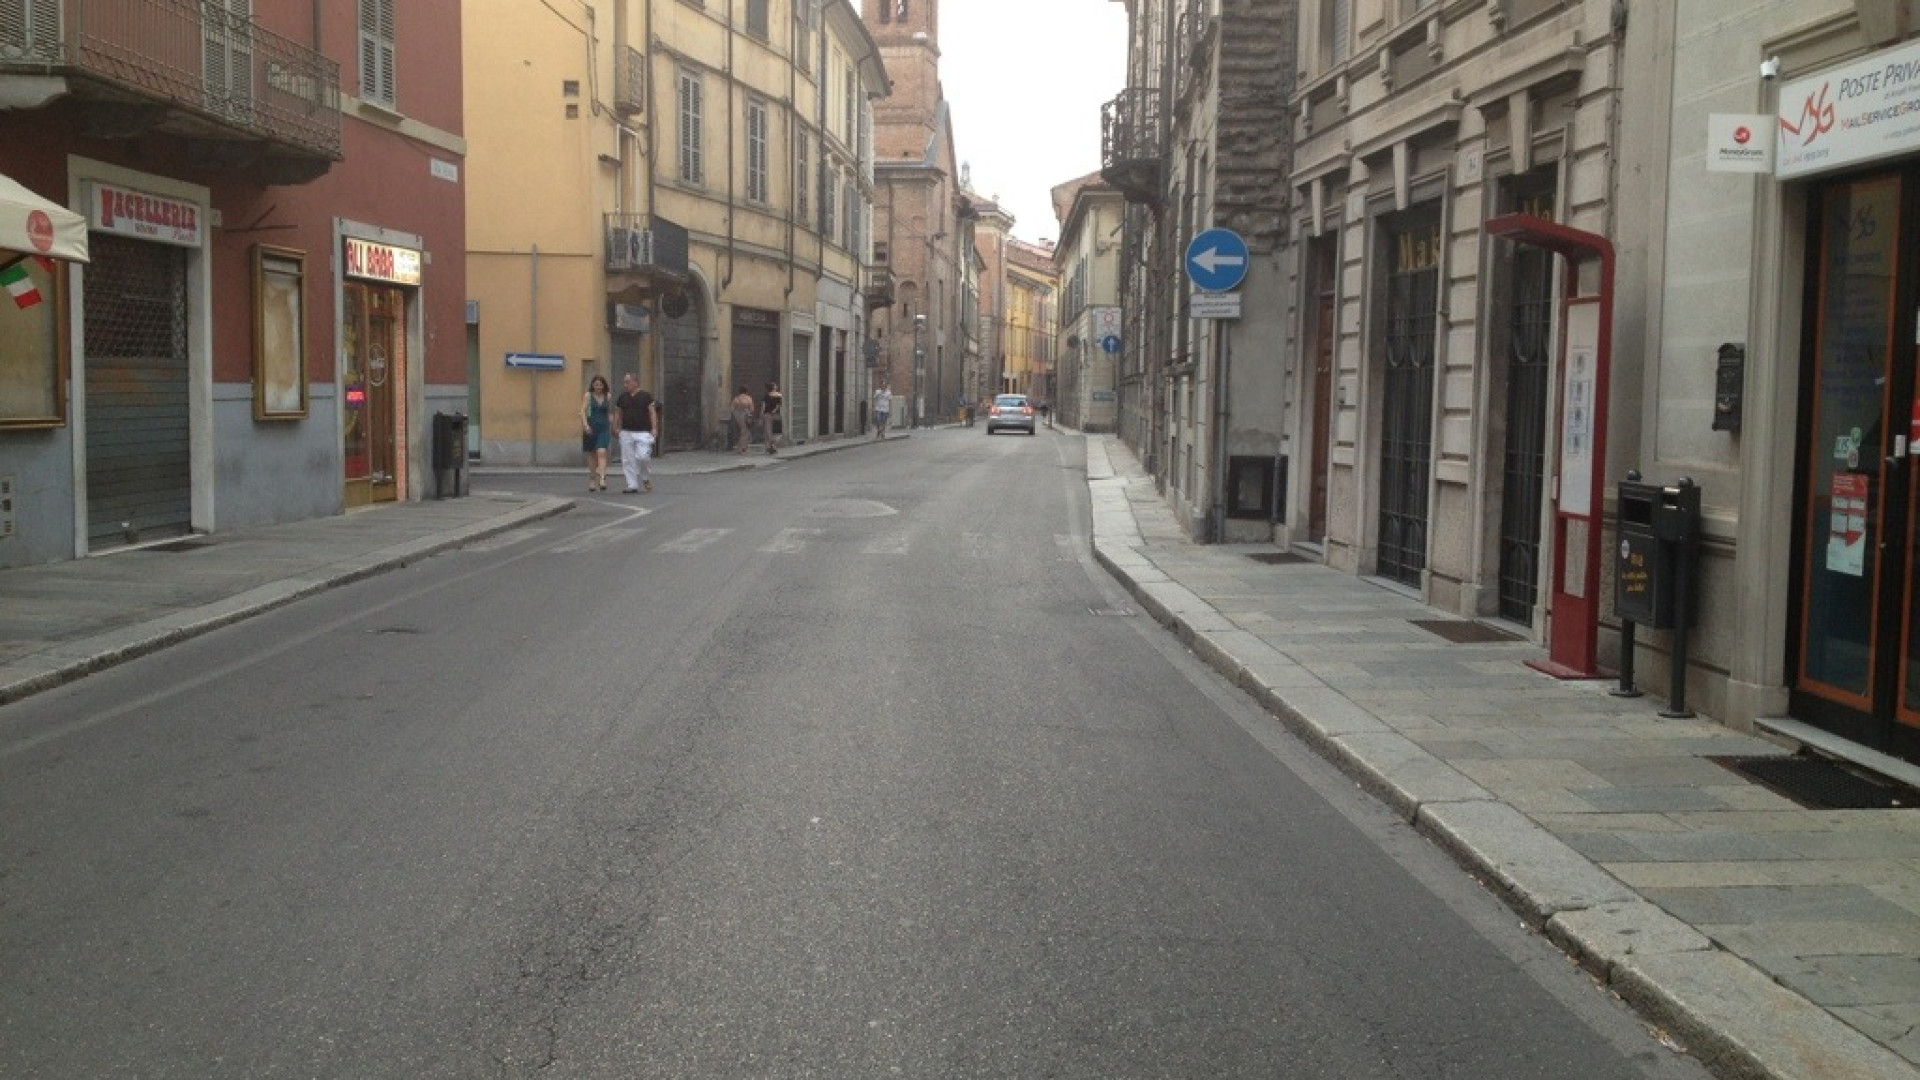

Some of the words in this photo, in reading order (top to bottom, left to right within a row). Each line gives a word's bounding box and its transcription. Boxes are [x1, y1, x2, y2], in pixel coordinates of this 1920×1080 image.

[1838, 71, 1881, 101] POSTE
[101, 187, 196, 231] MACELLERIA
[367, 244, 394, 280] BABA
